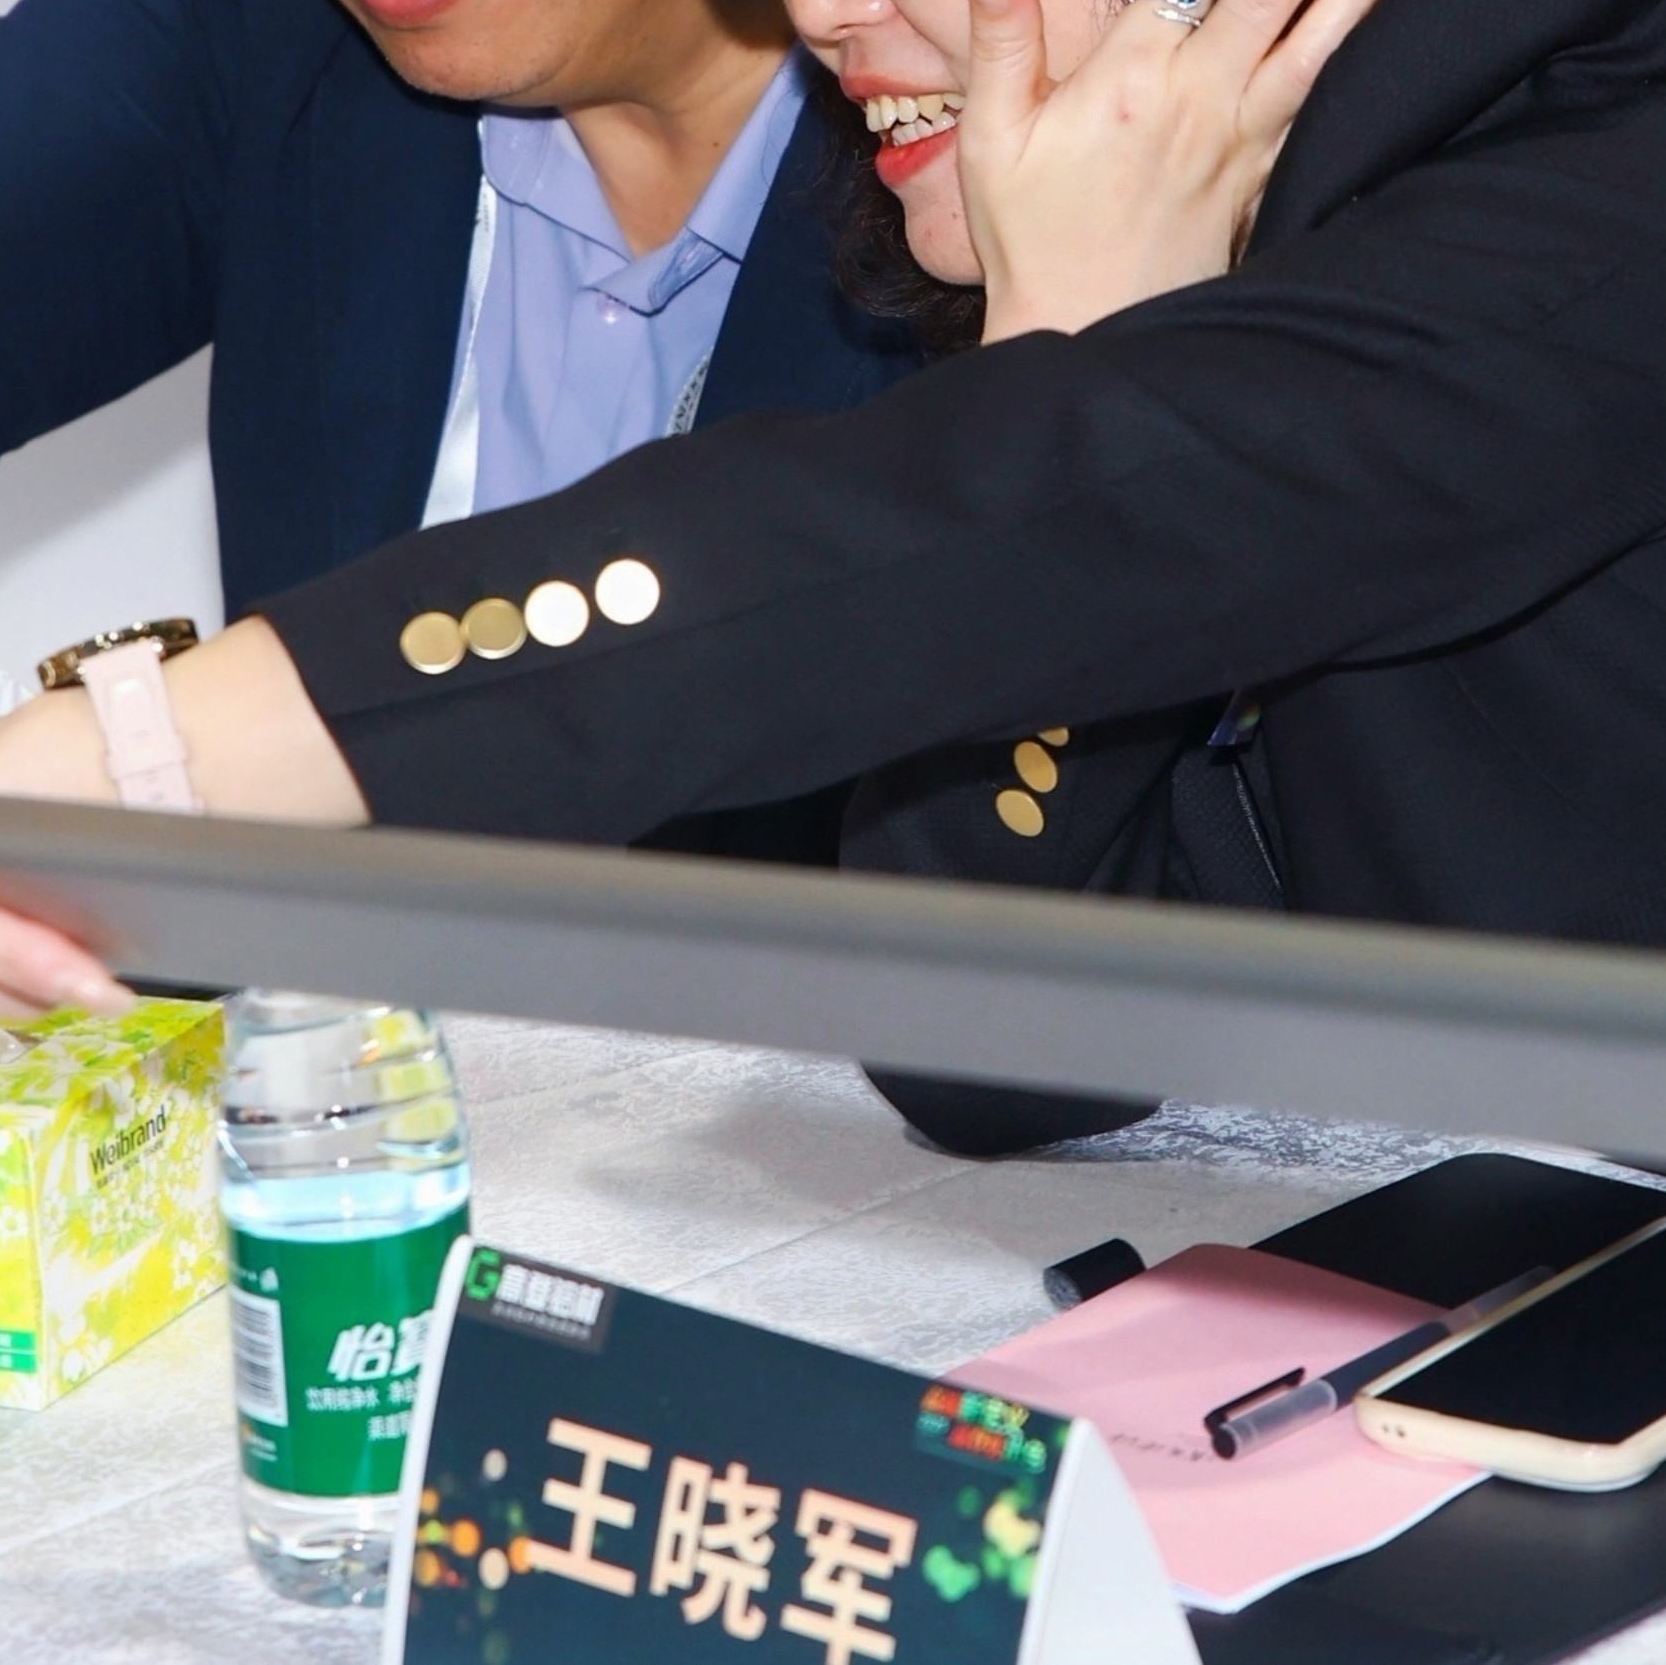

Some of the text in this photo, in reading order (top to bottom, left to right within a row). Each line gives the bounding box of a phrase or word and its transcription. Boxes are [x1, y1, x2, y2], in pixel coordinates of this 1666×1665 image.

[90, 1104, 167, 1175] Weibrand
[528, 1417, 919, 1665] 王晓军
